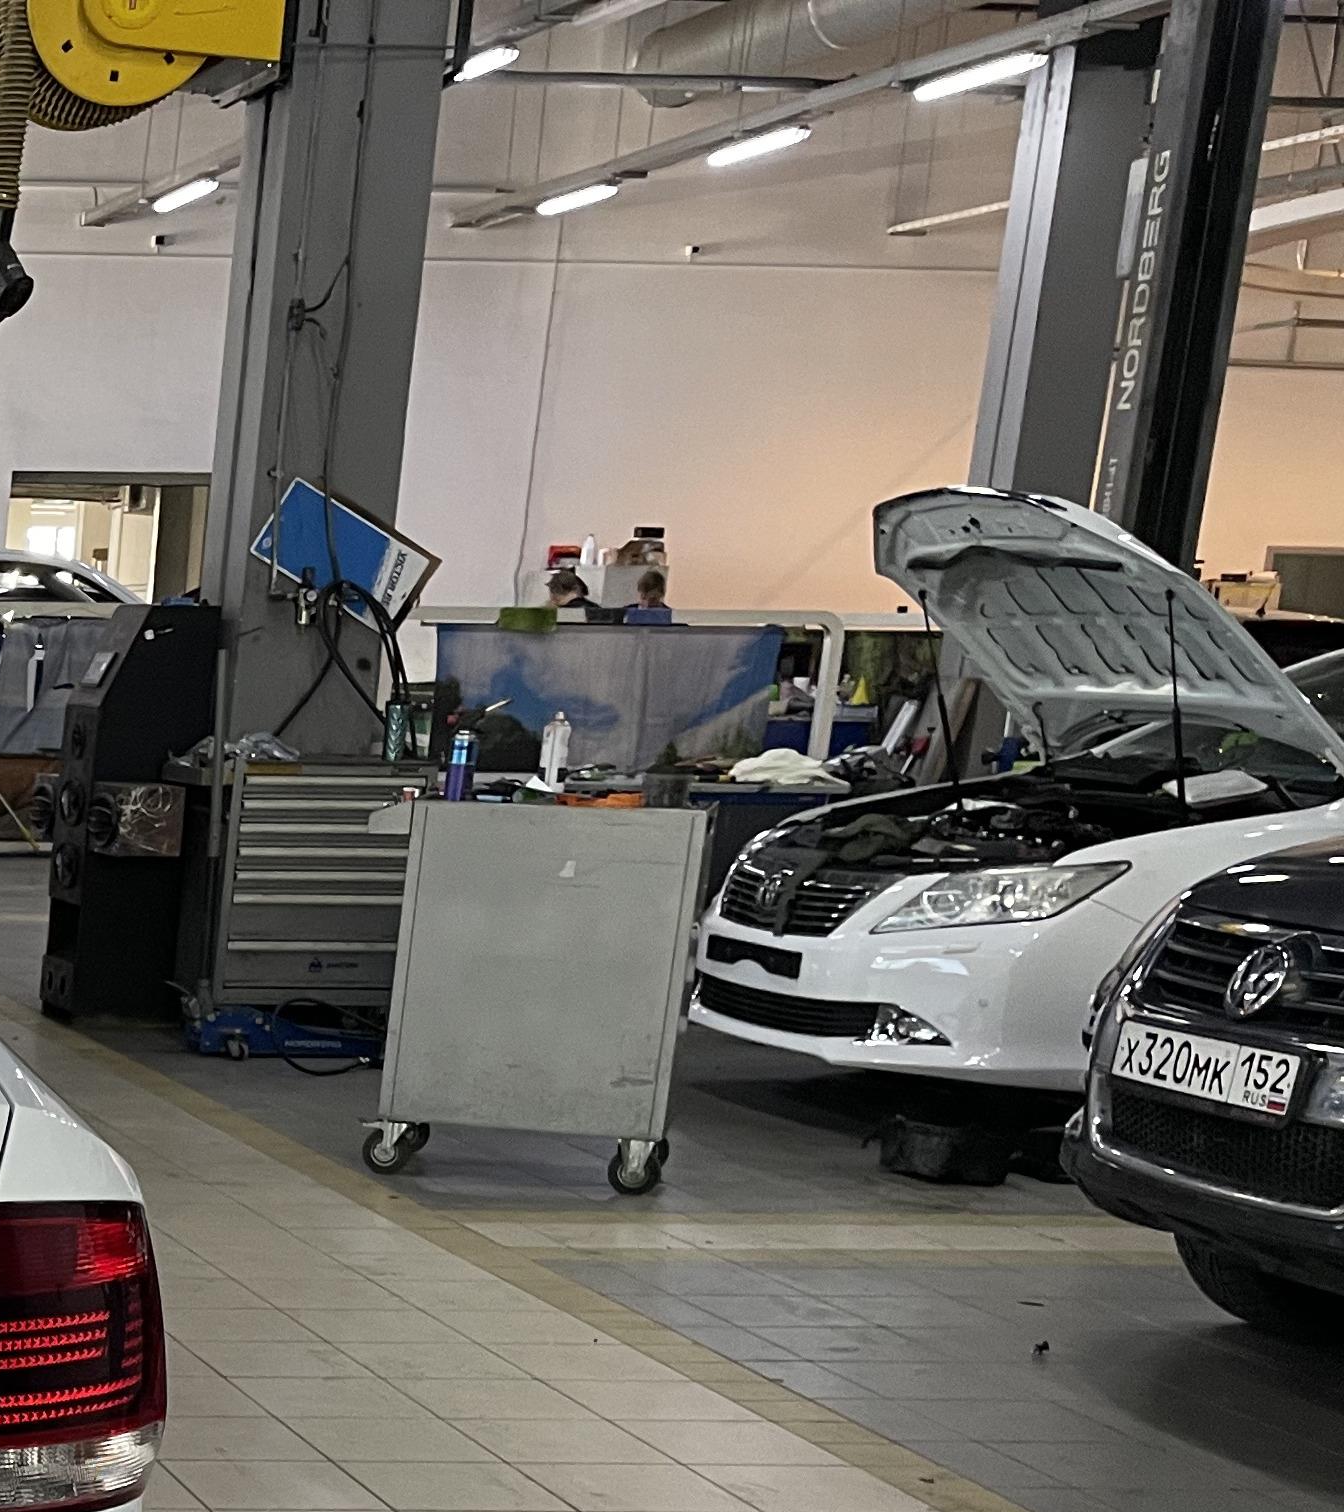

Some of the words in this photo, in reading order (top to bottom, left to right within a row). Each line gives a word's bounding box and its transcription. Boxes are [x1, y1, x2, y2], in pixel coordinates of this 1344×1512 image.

[1116, 150, 1170, 410] NORDBERG
[1240, 1052, 1291, 1095] 152
[1242, 1089, 1268, 1108] RUS
